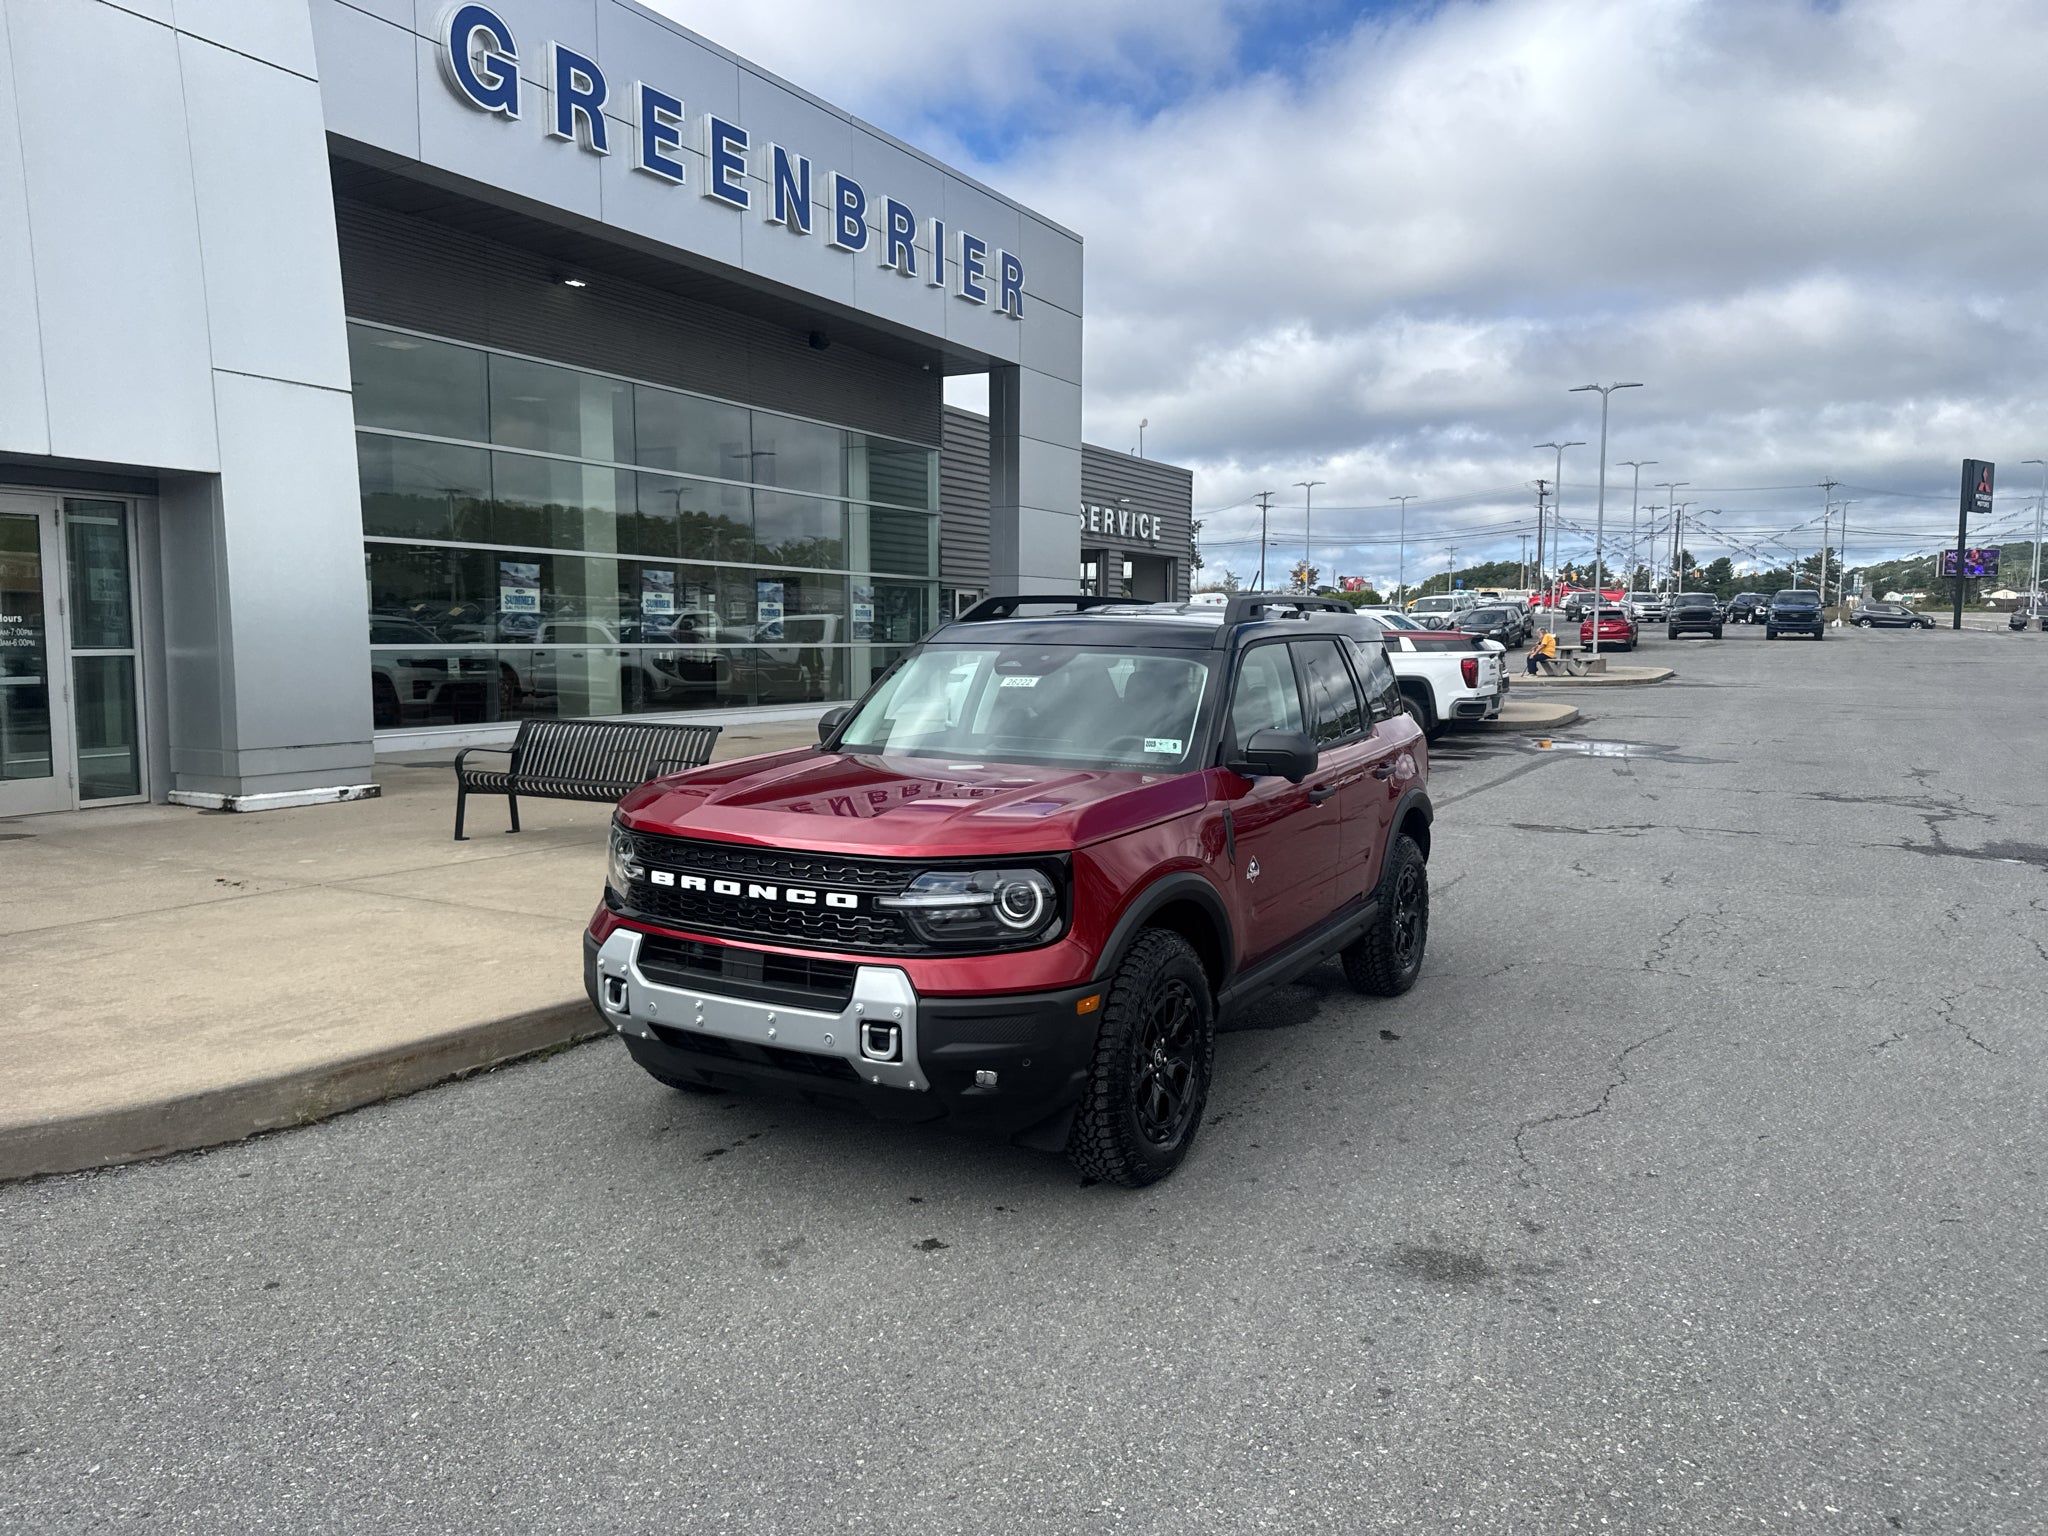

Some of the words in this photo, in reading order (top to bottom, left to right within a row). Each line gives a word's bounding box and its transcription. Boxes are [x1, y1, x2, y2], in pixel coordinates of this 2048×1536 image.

[440, 2, 1026, 320] GREENBRIER
[505, 594, 536, 606] SUMMER
[645, 599, 671, 608] SUMMER
[1005, 678, 1033, 686] 26222
[650, 870, 859, 909] BRONCO
